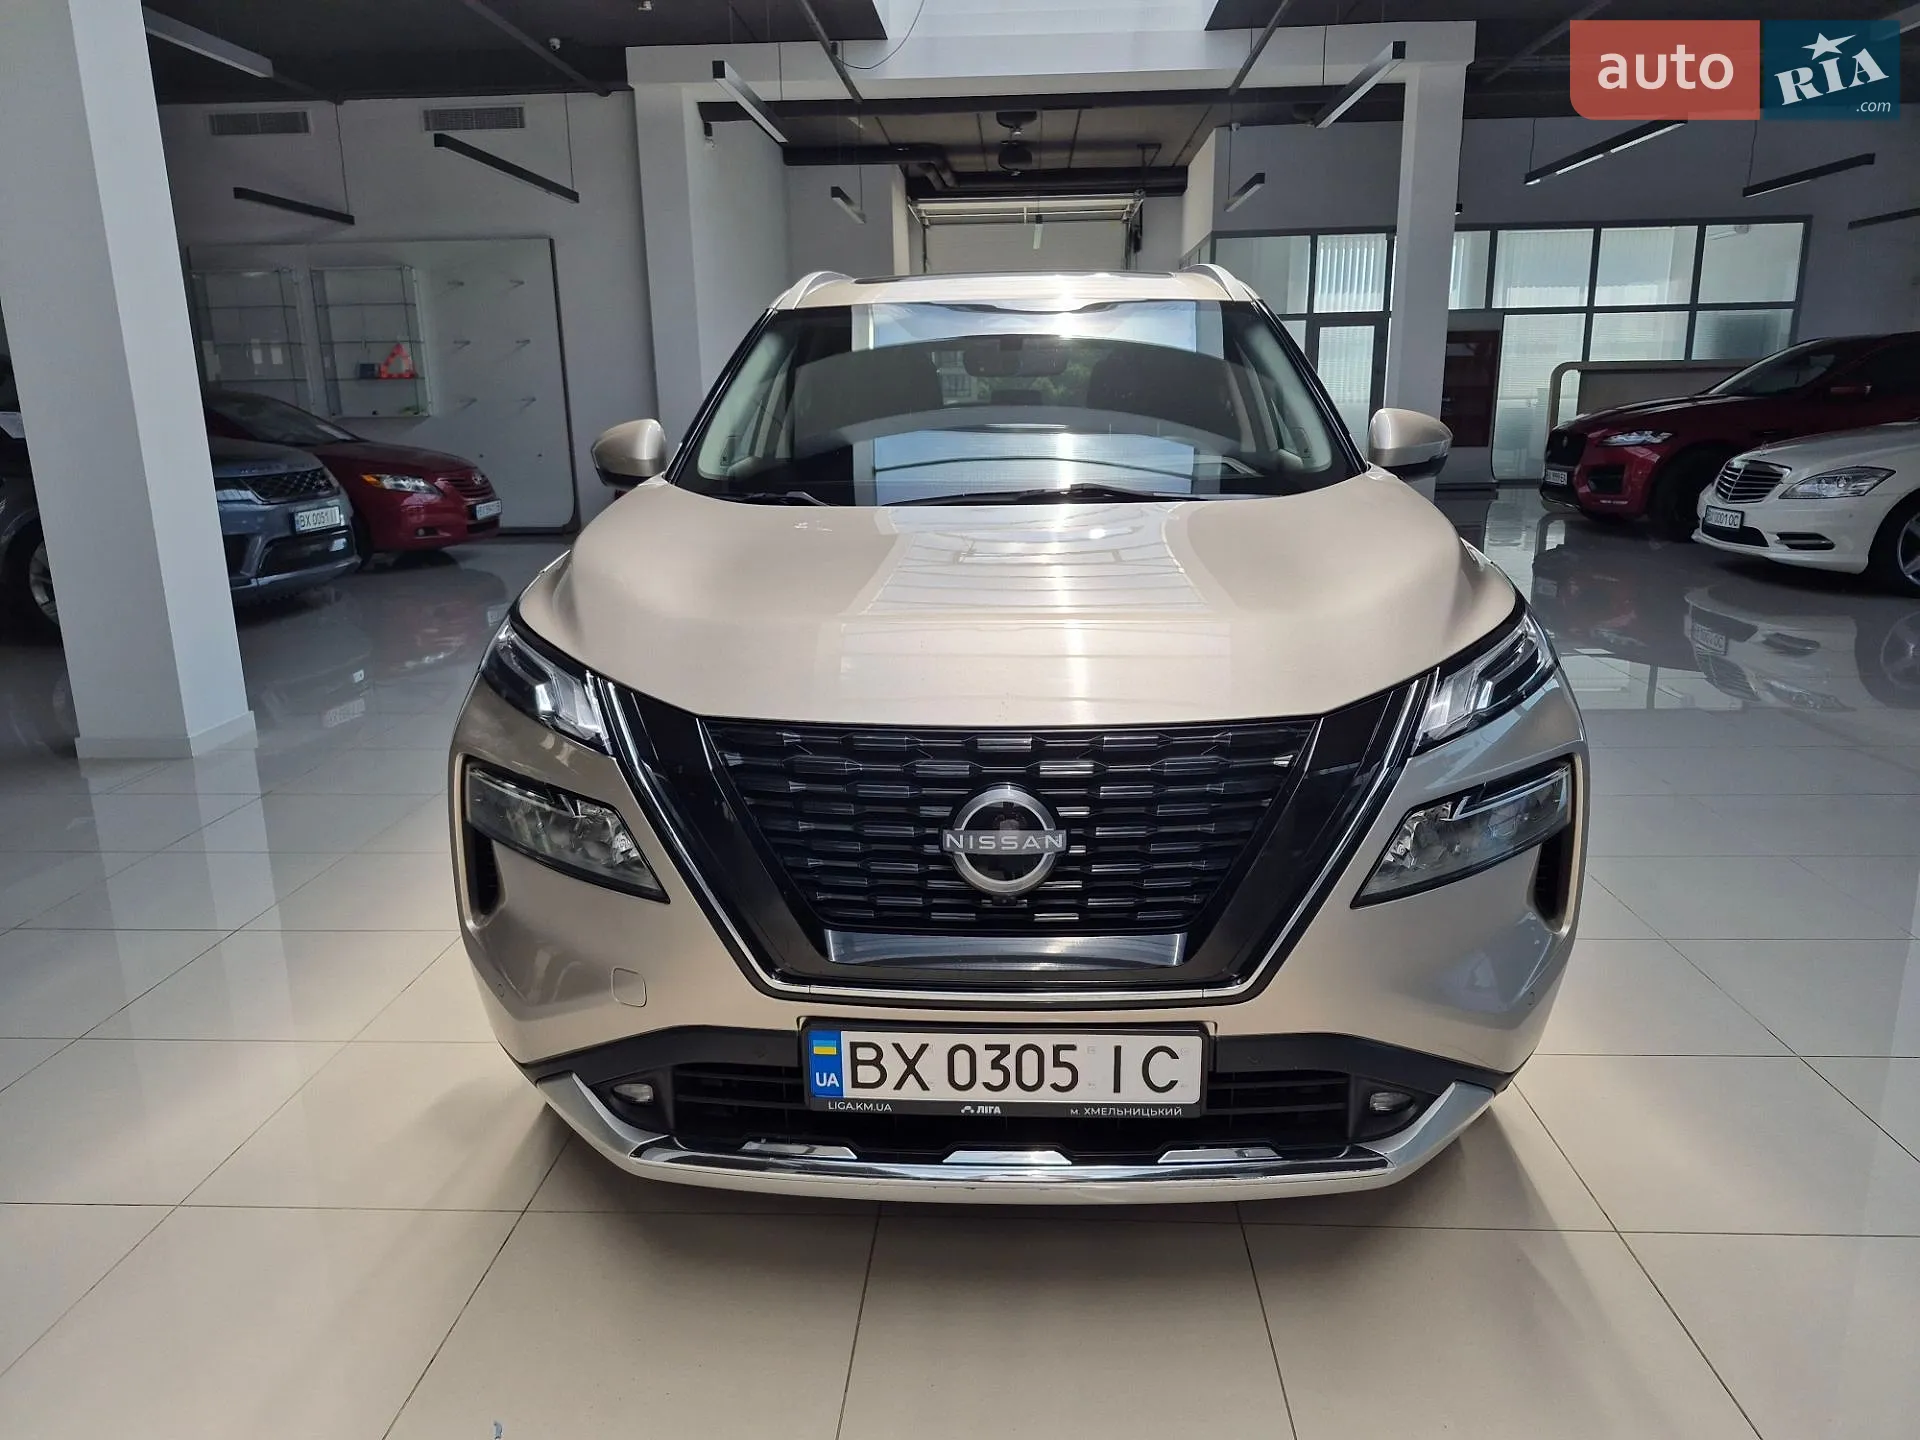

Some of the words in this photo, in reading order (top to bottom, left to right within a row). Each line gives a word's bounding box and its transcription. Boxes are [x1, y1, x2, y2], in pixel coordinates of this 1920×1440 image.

[946, 833, 1063, 850] NISSAN
[849, 1041, 930, 1091] BX
[947, 1043, 1079, 1093] 0305
[815, 1071, 839, 1087] UA
[828, 1101, 892, 1112] LIGA.KM.UA
[976, 1105, 1001, 1114] ЛІГА
[1083, 1106, 1182, 1117] ХМЕЛЬНИЦЬКИЙ
